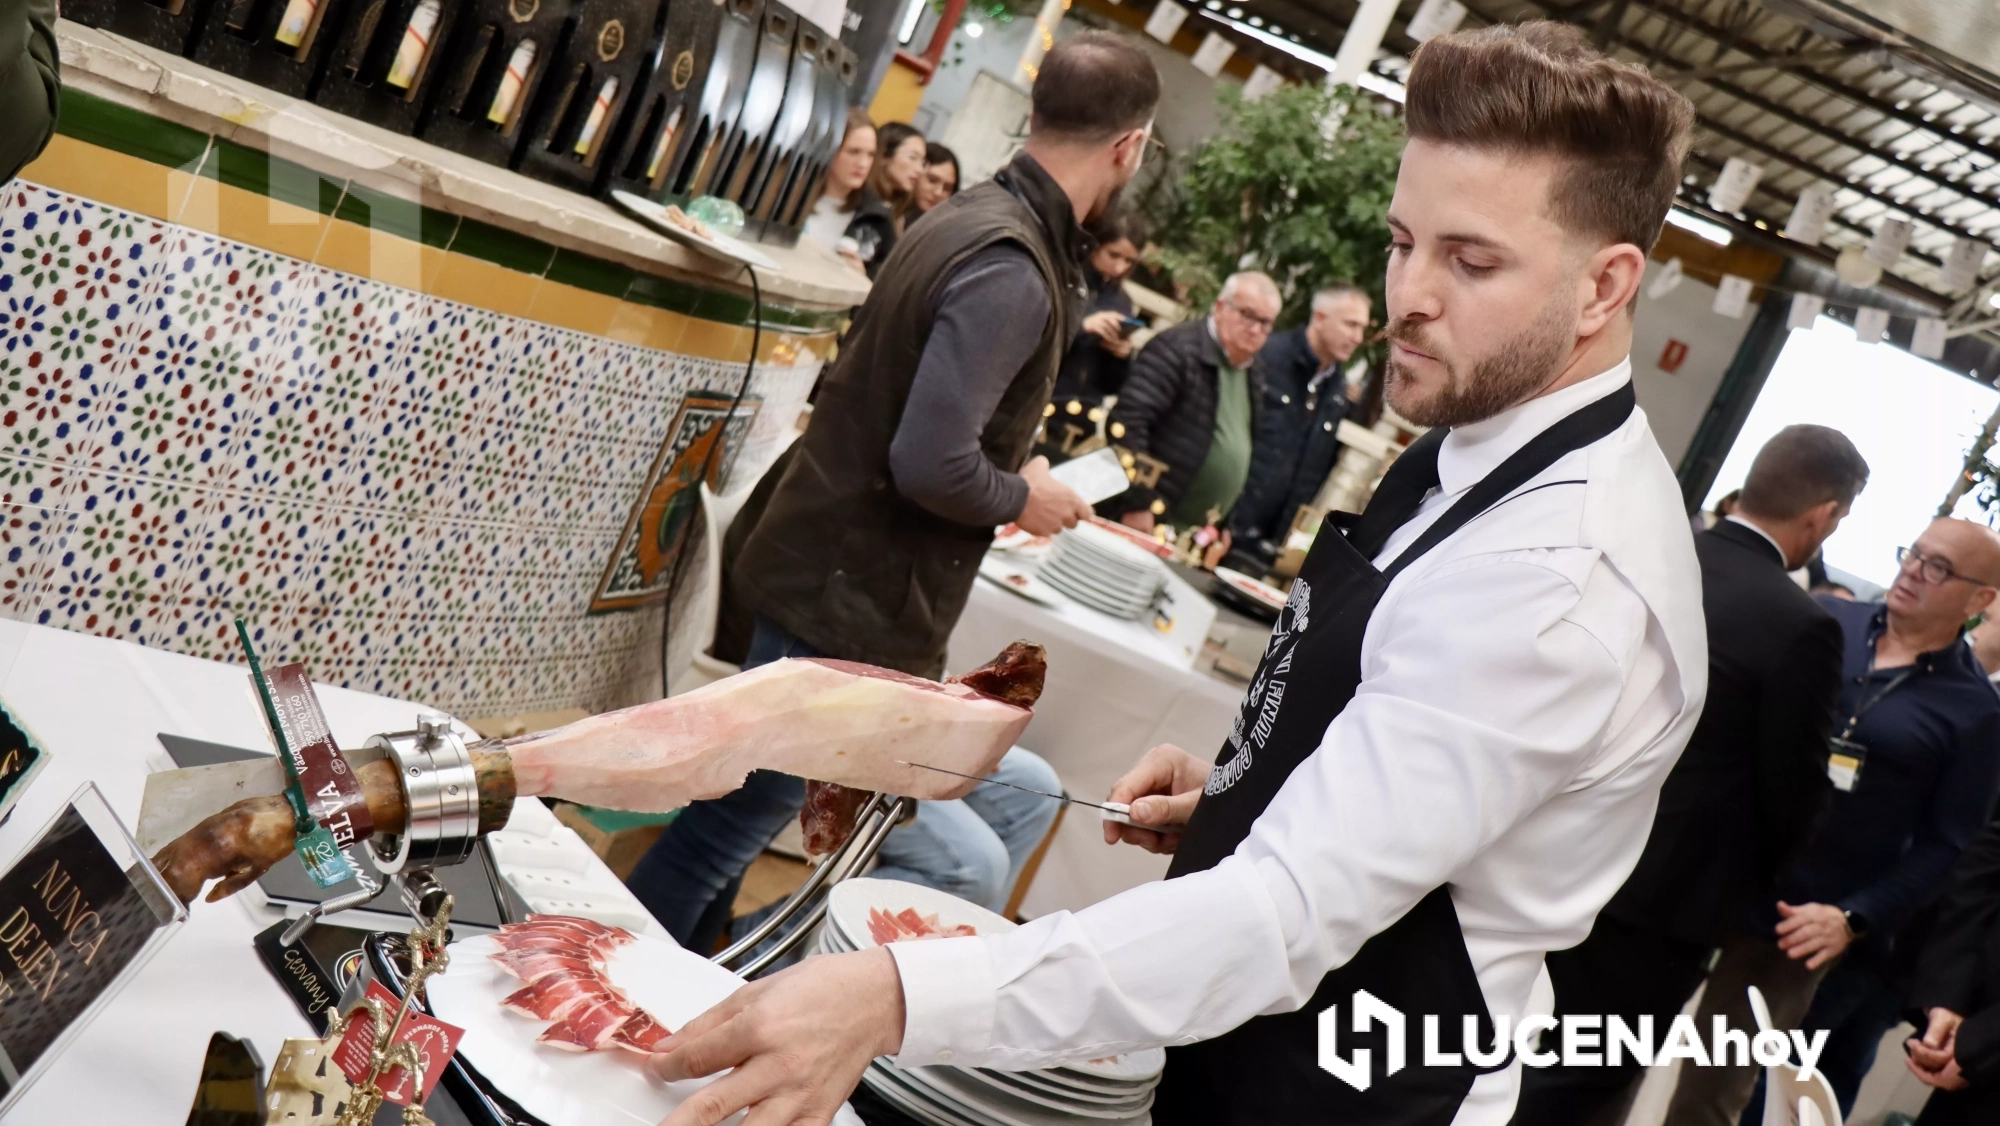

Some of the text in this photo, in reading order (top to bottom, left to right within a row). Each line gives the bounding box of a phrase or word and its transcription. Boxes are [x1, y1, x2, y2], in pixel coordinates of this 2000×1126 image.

[272, 695, 290, 728] Moya
[291, 695, 316, 747] 959 710 160
[1250, 680, 1286, 749] FINAL
[284, 730, 308, 775] Vázquez
[32, 859, 109, 966] NUNCA
[0, 906, 69, 1002] DEJEN
[284, 949, 330, 1014] Geovany
[403, 1024, 441, 1040] HERMANOS
